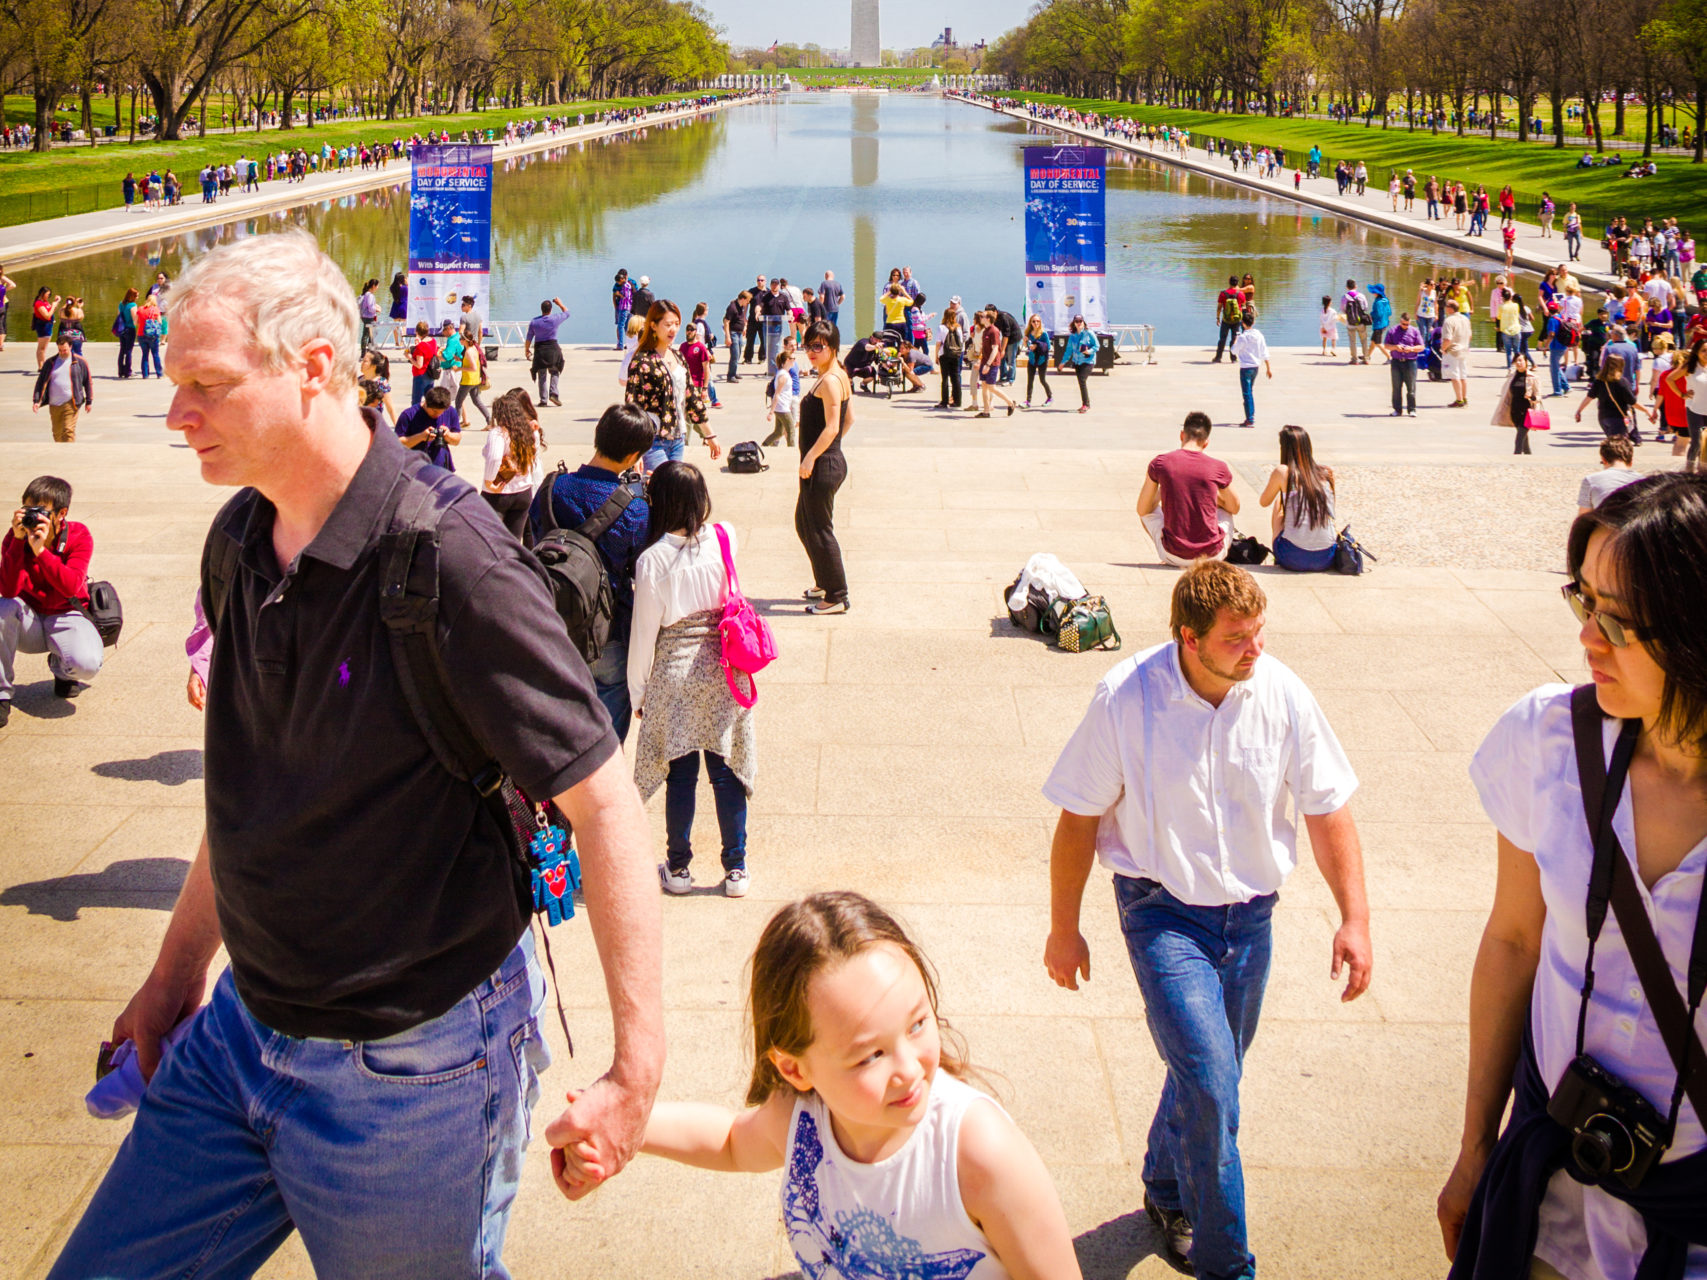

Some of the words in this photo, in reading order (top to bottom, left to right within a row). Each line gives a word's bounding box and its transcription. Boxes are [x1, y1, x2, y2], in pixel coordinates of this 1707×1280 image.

[417, 166, 487, 177] MONUMENTAL
[1030, 168, 1100, 179] MONUMENTAL
[417, 178, 433, 187] DAY
[435, 178, 446, 187] OF
[448, 178, 487, 187] SERVICE:
[1030, 180, 1046, 189] DAY
[1048, 180, 1060, 189] OF
[1061, 180, 1100, 189] SERVICE:
[418, 261, 433, 269] With
[435, 261, 462, 270] Support
[463, 261, 483, 269] From:
[1034, 264, 1050, 272] With
[1051, 264, 1078, 273] Support
[1080, 264, 1098, 272] From:
